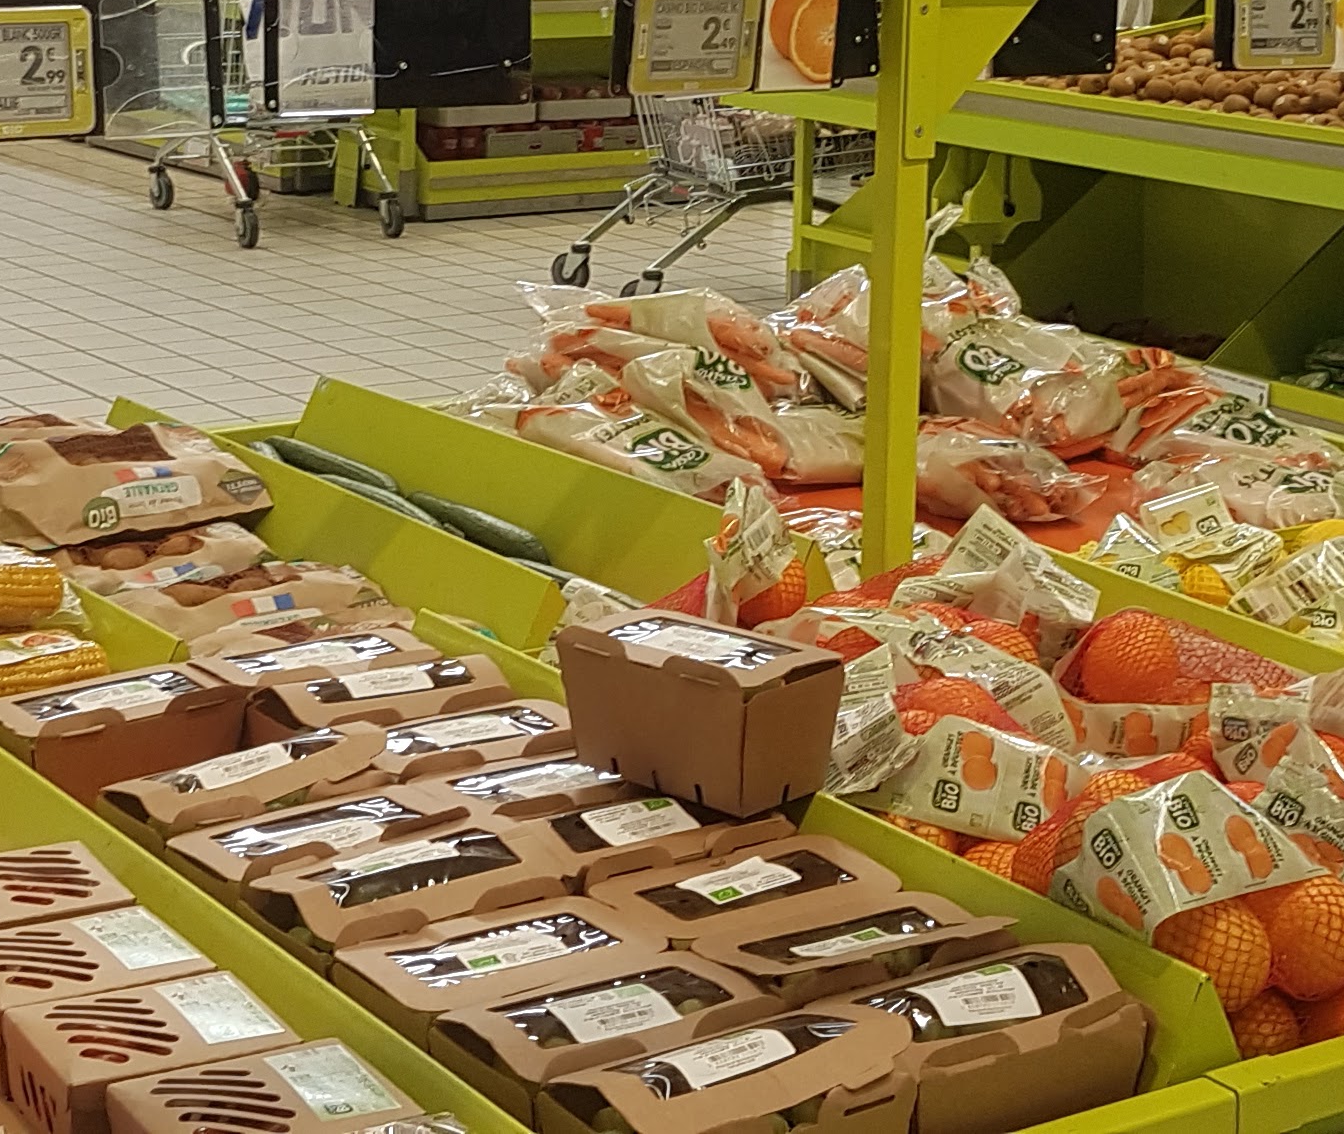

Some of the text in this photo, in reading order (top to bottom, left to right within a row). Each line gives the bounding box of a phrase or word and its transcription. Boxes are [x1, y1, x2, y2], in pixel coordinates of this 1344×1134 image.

[88, 505, 118, 529] BIO
[941, 783, 959, 811] BIO
[1022, 806, 1039, 831] BIO
[1169, 799, 1191, 828] BIO
[1271, 800, 1298, 827] BIO
[1093, 835, 1118, 867] BIO
